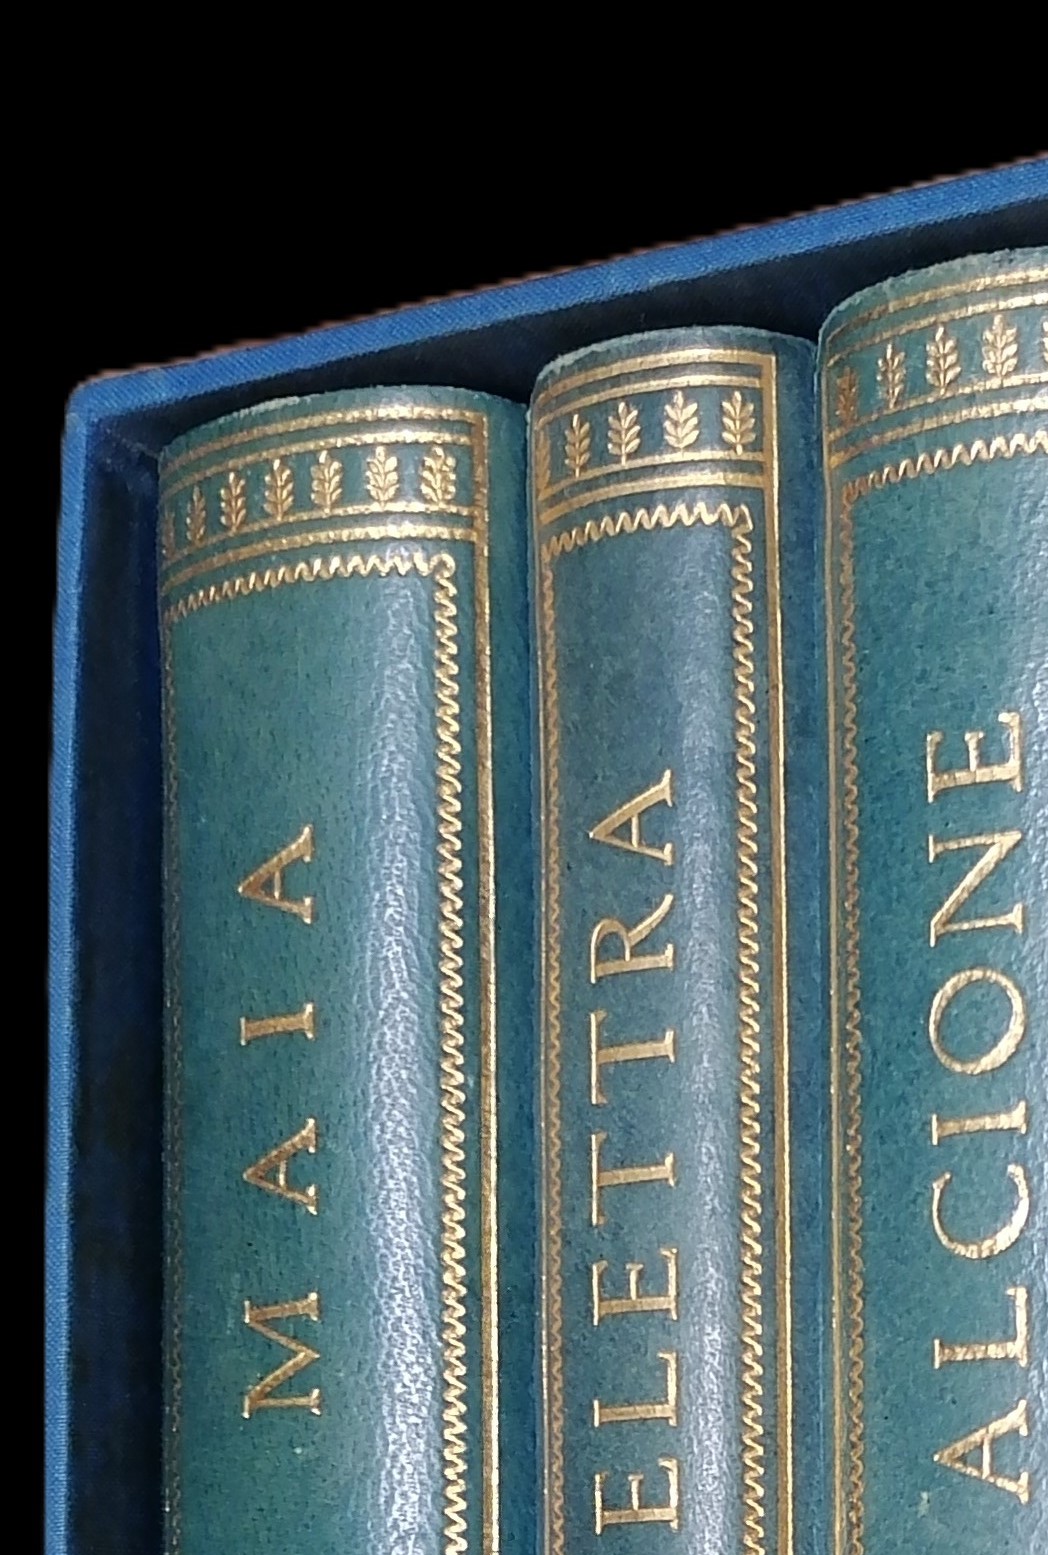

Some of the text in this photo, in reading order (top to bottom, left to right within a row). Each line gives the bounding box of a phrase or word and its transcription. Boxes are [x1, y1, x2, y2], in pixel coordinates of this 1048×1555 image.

[238, 824, 321, 1419] MAIA
[589, 769, 679, 1535] ELETTRA
[926, 712, 1030, 1504] ALCIONE
